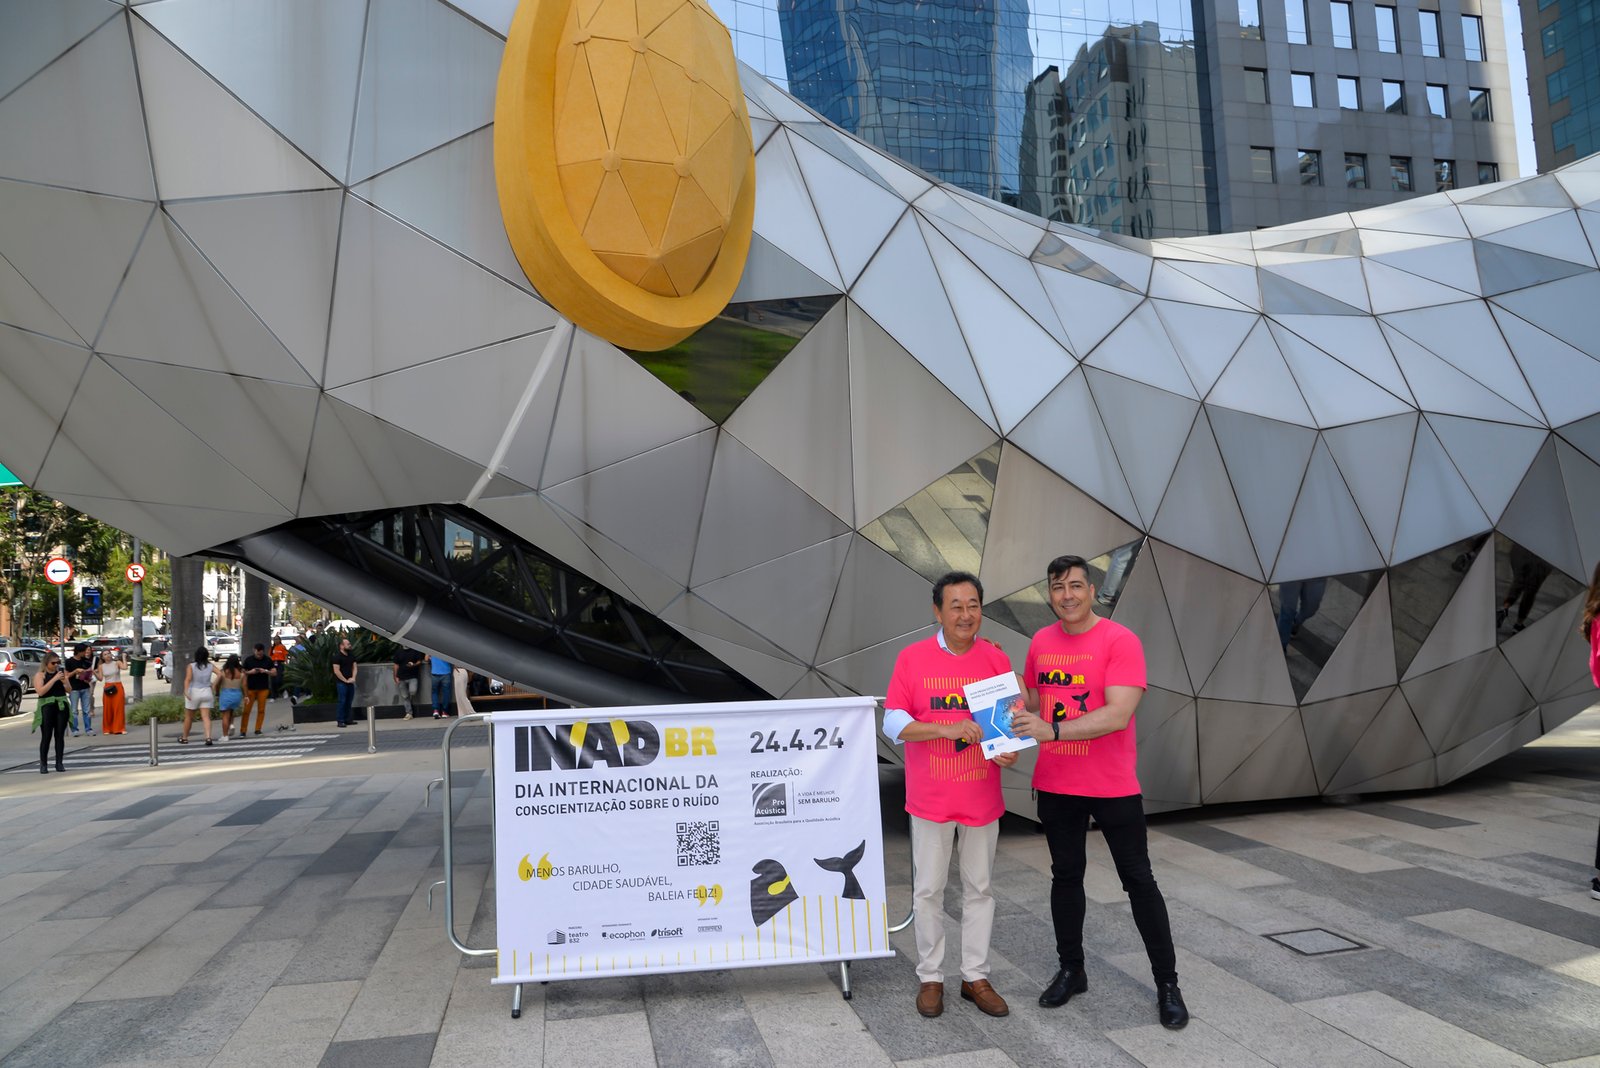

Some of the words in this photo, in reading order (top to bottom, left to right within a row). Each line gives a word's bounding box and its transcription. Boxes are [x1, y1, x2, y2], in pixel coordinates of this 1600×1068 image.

[750, 727, 844, 753] 24.4.24
[750, 768, 803, 778] REALIZAÇÃO:
[515, 784, 544, 799] DIA
[550, 776, 690, 797] INTERNACIONAL
[696, 774, 718, 789] DA
[515, 799, 626, 816] CONSCIENTIZAÇÃO
[629, 798, 669, 810] SOBRE
[672, 798, 680, 808] O
[683, 793, 719, 807] RUÍDO
[756, 807, 785, 815] Acústica
[526, 866, 565, 878] MENOS
[568, 863, 621, 876] BARULHO,
[573, 878, 613, 891] CIDADE
[615, 875, 673, 889] SAUDÁVEL,
[648, 888, 684, 901] BALEIA
[687, 888, 717, 899] FELIZ!
[609, 930, 646, 940] ecophon
[657, 927, 683, 937] trisoft
